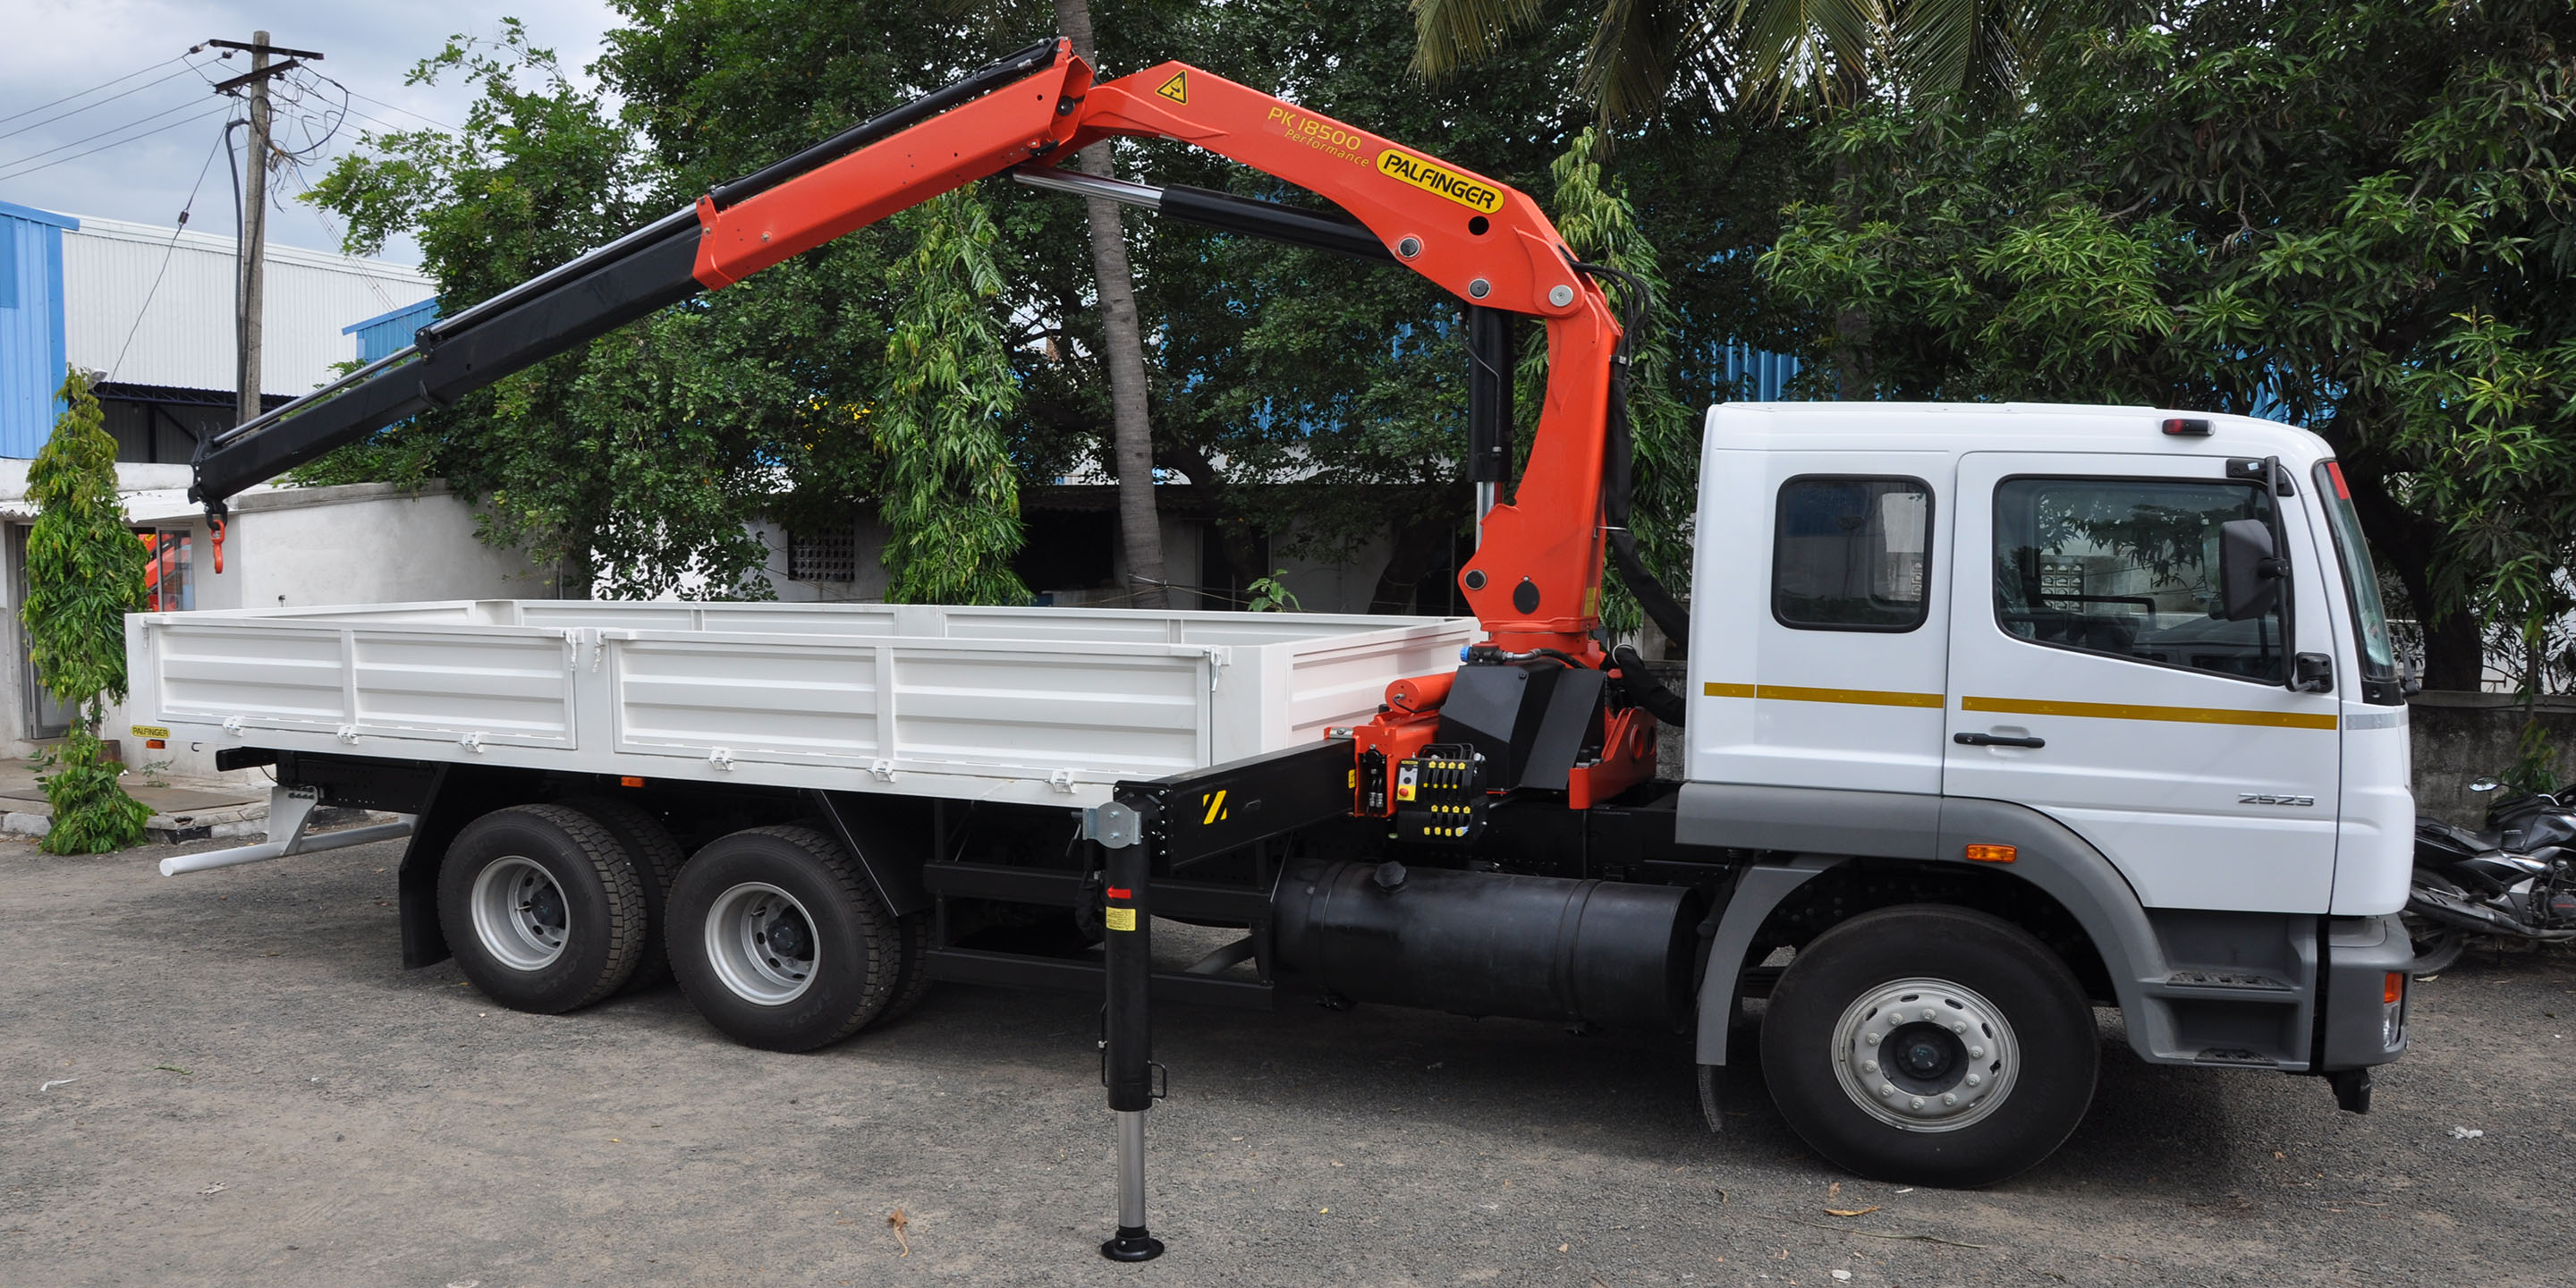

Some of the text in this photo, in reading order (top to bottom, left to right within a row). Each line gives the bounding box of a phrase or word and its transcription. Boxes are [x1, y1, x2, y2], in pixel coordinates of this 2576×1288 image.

[1267, 106, 1361, 150] PK 18500
[1284, 128, 1370, 167] Performance
[1384, 154, 1496, 209] PALFINGER
[132, 726, 169, 737] PALFINGER
[2238, 792, 2315, 807] 2523
